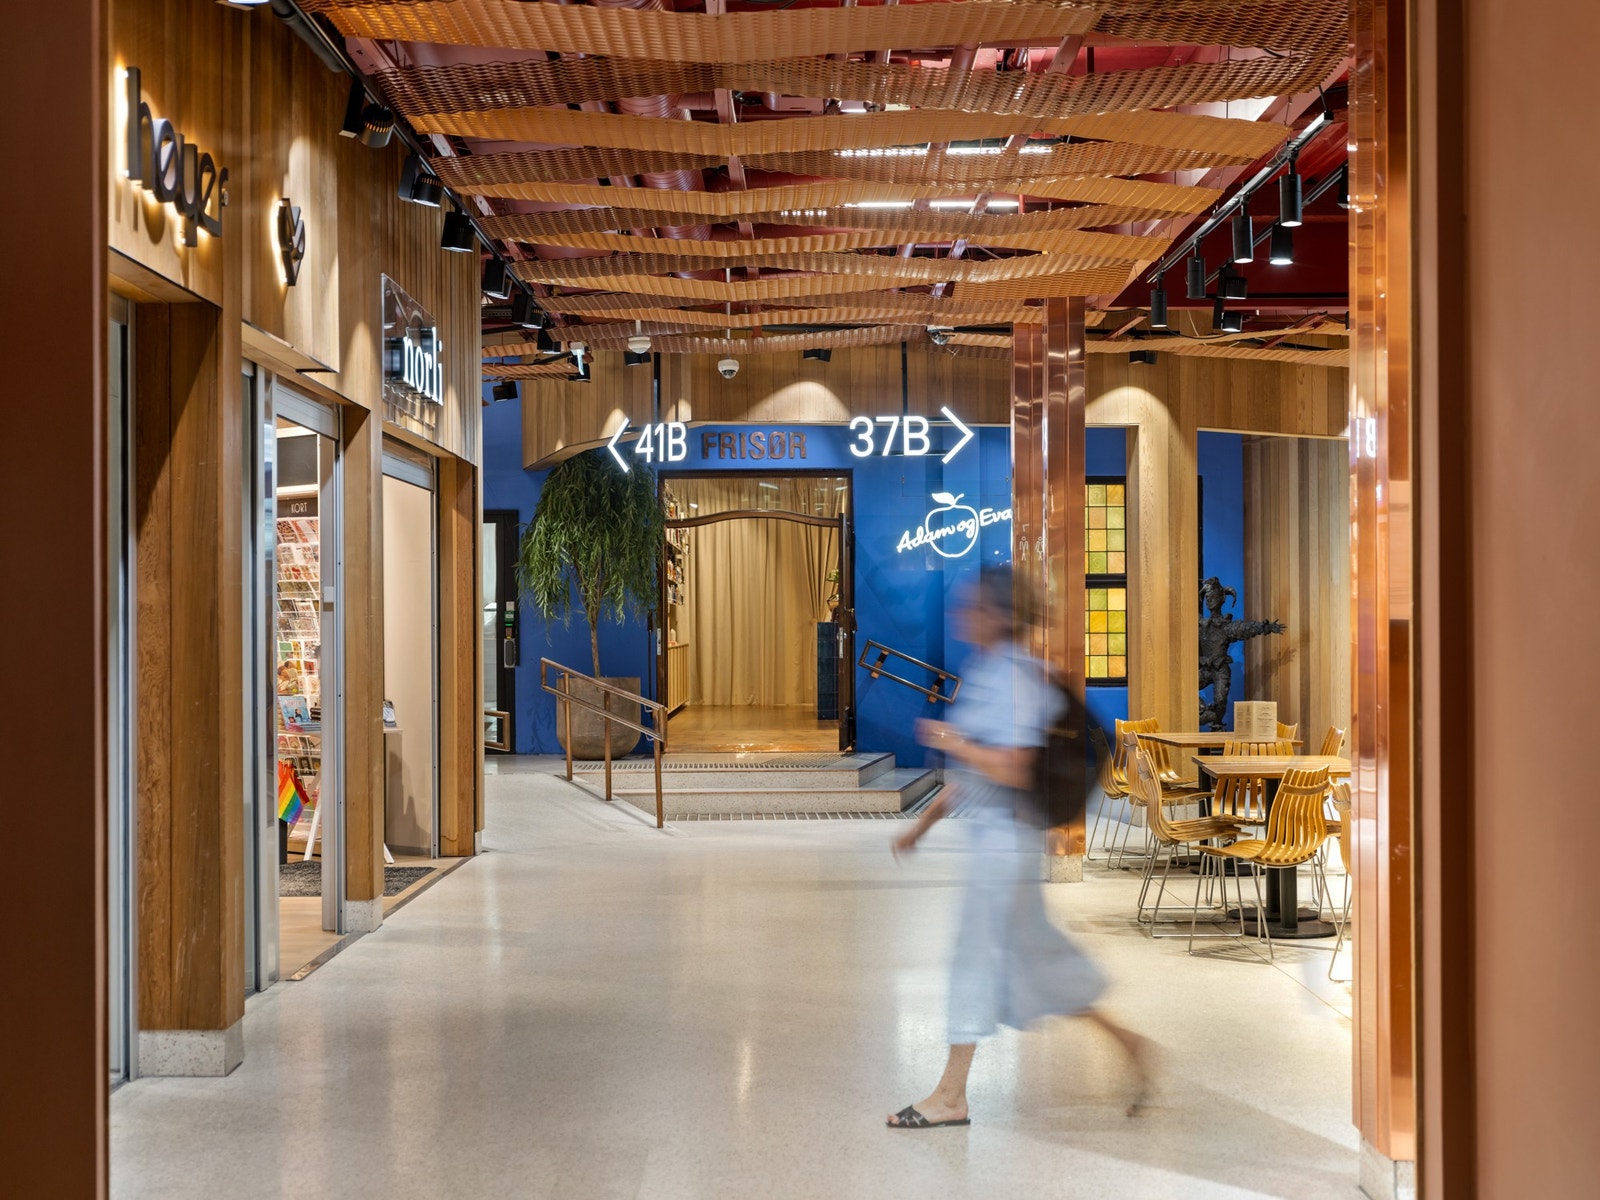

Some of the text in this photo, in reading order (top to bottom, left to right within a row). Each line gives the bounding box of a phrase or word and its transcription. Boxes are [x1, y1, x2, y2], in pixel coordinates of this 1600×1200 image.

[403, 326, 444, 406] norli
[634, 422, 687, 463] 41B
[702, 431, 807, 460] FRISØR
[849, 416, 931, 458] 37B
[291, 503, 307, 514] KORT
[896, 508, 1012, 553] Adam og Eva
